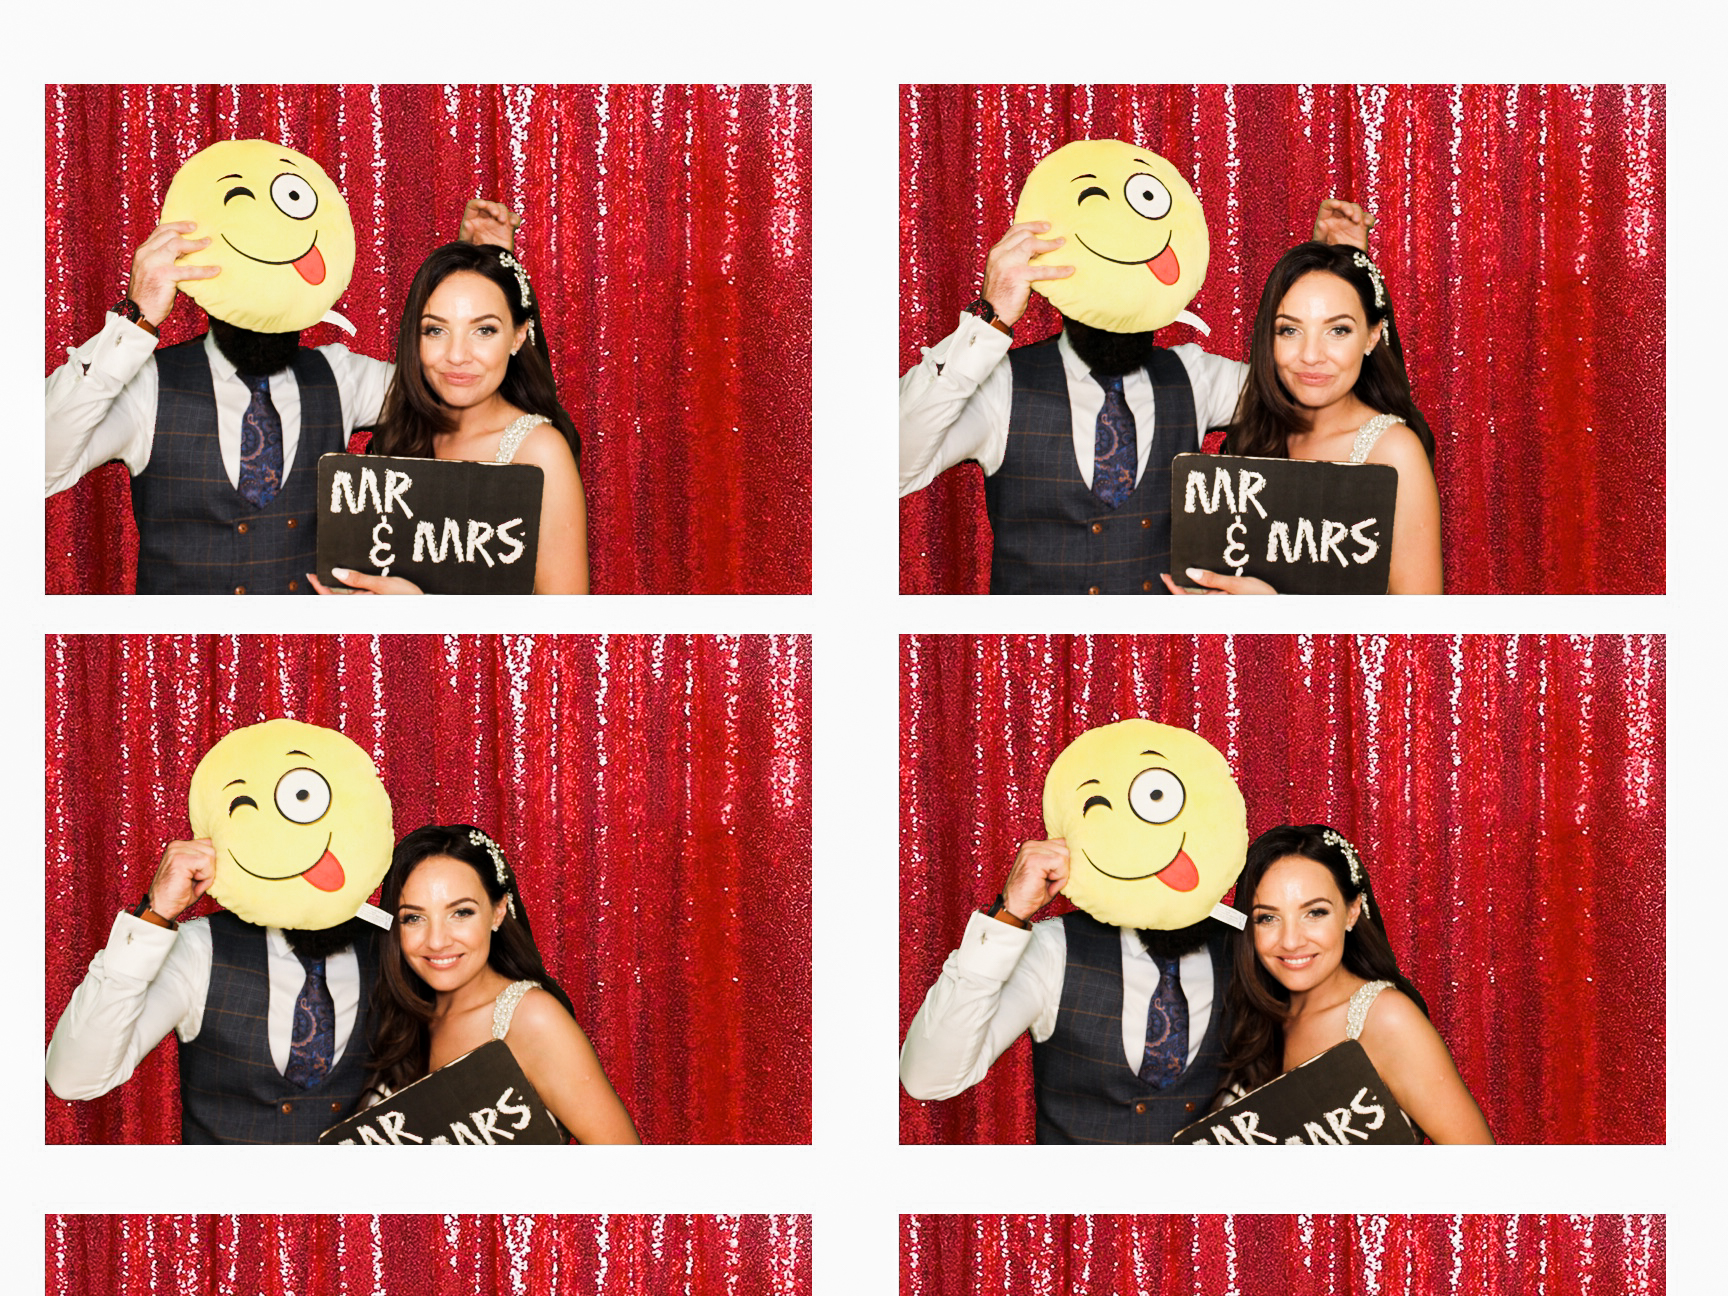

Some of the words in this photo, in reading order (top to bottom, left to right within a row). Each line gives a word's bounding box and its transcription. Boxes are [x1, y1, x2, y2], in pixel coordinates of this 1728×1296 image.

[330, 466, 413, 519] MR
[1184, 466, 1267, 519] MR
[368, 515, 395, 576] &
[411, 517, 526, 568] MRS
[1222, 515, 1249, 576] &
[1265, 517, 1380, 568] MRS
